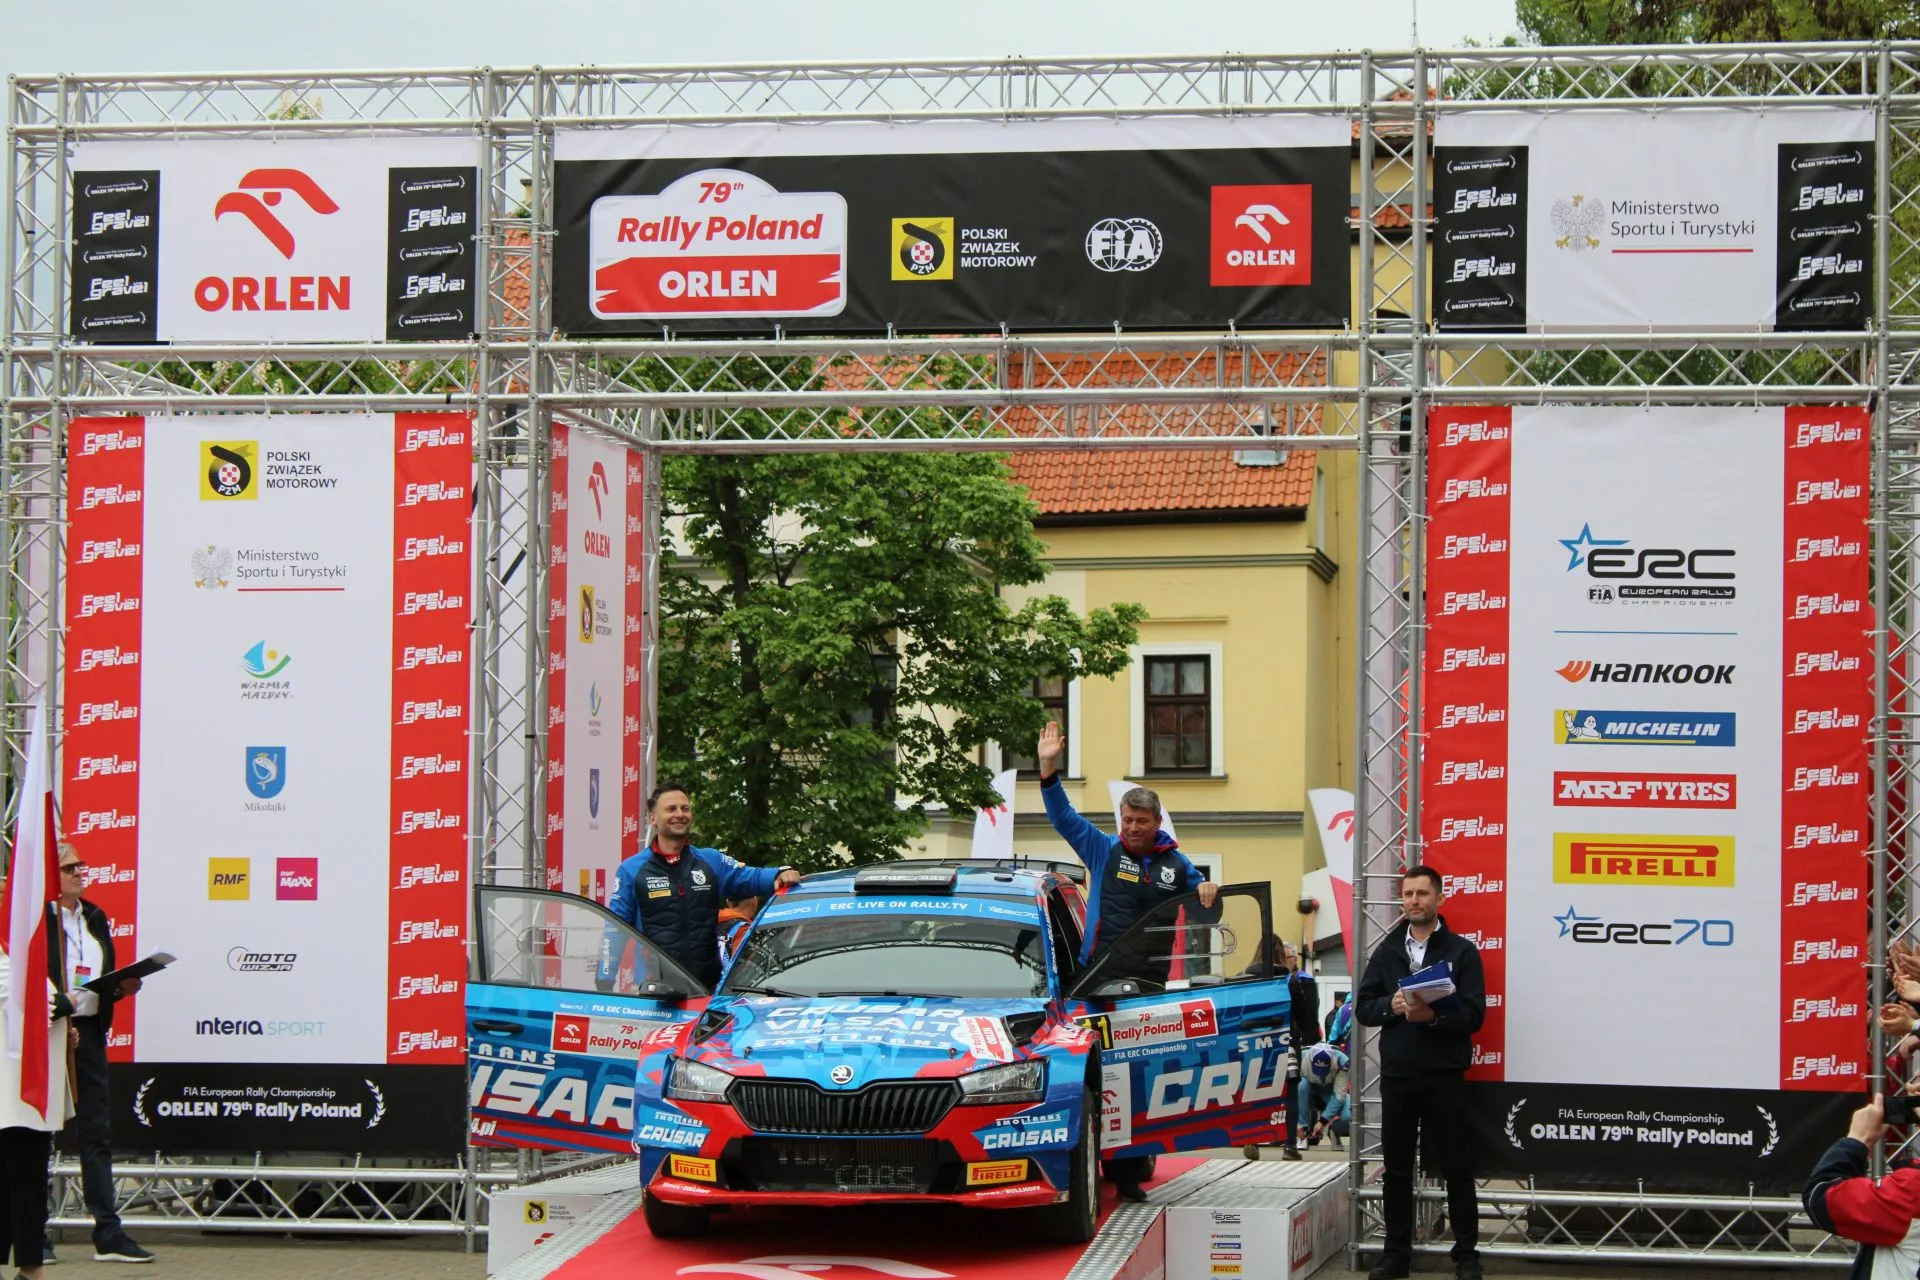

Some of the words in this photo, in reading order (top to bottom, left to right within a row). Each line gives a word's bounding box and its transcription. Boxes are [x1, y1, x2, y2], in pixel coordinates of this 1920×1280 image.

[698, 182, 744, 204] 79th
[1455, 187, 1497, 202] Feel
[1801, 183, 1842, 199] Feel
[1447, 193, 1517, 213] gravel
[1610, 200, 1719, 215] Ministerstwo
[1792, 189, 1863, 211] gravel
[92, 210, 130, 224] Feel
[408, 206, 447, 221] Feel
[84, 216, 149, 235] gravel
[400, 212, 466, 232] gravel
[1610, 220, 1665, 238] Sportu
[1670, 221, 1676, 236] i
[1680, 219, 1755, 238] Turystyki
[617, 216, 702, 250] Rally
[705, 213, 824, 242] Poland
[961, 228, 1008, 240] POLSKI
[961, 241, 1020, 256] ZWIĄZEK
[961, 255, 1037, 268] MOTOROWY
[1226, 249, 1295, 266] ORLEN
[1454, 256, 1495, 271] Feel
[1800, 254, 1841, 269] Feel
[910, 263, 935, 275] PZM
[1446, 262, 1515, 282] gravel
[1791, 260, 1862, 281] gravel
[91, 276, 129, 290] Feel
[408, 273, 446, 288] Feel
[658, 270, 777, 299] ORLEN
[83, 282, 148, 301] gravel
[194, 276, 351, 312] ORLEN
[400, 279, 465, 299] gravel
[1799, 422, 1841, 436] Feel
[1791, 428, 1861, 447] gravel
[267, 452, 310, 461] POLSKI
[266, 465, 322, 477] ZWIĄZEK
[85, 484, 122, 498] Feel
[218, 484, 241, 496] PZM
[266, 478, 338, 488] MOTOROWY
[1446, 477, 1487, 492] Feel
[77, 490, 141, 509] gravel
[1438, 483, 1507, 503] gravel
[407, 536, 444, 550] Feel
[584, 530, 610, 559] ORLEN
[237, 549, 319, 561] Ministerstwo
[399, 542, 463, 561] gravel
[1587, 548, 1736, 579] ERC
[236, 565, 278, 579] Sportu
[282, 565, 286, 577] i
[290, 565, 346, 579] Turystyki
[1445, 590, 1486, 604] Feel
[1621, 588, 1689, 596] EUROPEAN
[1691, 588, 1733, 596] RALLY
[1437, 596, 1506, 615] gravel
[1788, 656, 1859, 676] gravel
[1797, 651, 1838, 665] Feel
[240, 681, 290, 689] WARMIA
[240, 691, 290, 699] MAZURY
[74, 706, 137, 726] gravel
[82, 701, 119, 715] Feel
[1444, 703, 1484, 717] Feel
[1436, 708, 1504, 728] gravel
[1605, 721, 1721, 737] MICHELIN
[1559, 779, 1642, 800] MRF
[1646, 781, 1731, 802] TYRES
[395, 814, 460, 834] gravel
[403, 809, 441, 823] Feel
[1570, 841, 1720, 877] PIRELLI
[213, 873, 246, 886] RMF
[830, 901, 854, 910] ERC
[858, 901, 886, 909] LIVE
[910, 901, 969, 910] RALLY.TV
[1787, 944, 1857, 964] gravel
[1795, 939, 1837, 953] Feel
[243, 953, 297, 963] MOTO
[241, 963, 293, 971] WIZJA
[392, 980, 457, 999] gravel
[400, 975, 438, 988] Feel
[592, 1004, 604, 1012] FIA
[607, 1005, 621, 1013] ERC
[622, 1007, 673, 1019] Championship
[196, 1017, 263, 1036] interia
[266, 1021, 326, 1036] SPORT
[764, 1016, 960, 1031] VILSAIT
[1113, 1029, 1142, 1041] Rally
[1143, 1020, 1183, 1036] Poland
[1190, 1021, 1209, 1029] ORLEN
[560, 1036, 581, 1044] ORLEN
[589, 1035, 621, 1051] Rally
[1114, 1052, 1126, 1060] FIA
[1127, 1050, 1140, 1058] ERC
[1142, 1043, 1187, 1056] Championship
[183, 1087, 198, 1097] FIA
[201, 1087, 243, 1099] European
[246, 1087, 268, 1100] Rally
[270, 1087, 336, 1099] Championship
[157, 1102, 218, 1117] ORLEN
[223, 1101, 252, 1117] 79th
[255, 1103, 298, 1122] Rally
[301, 1103, 362, 1119] Poland
[1559, 1109, 1574, 1119] FIA
[1576, 1109, 1623, 1123] European
[1626, 1110, 1650, 1125] Rally
[1652, 1111, 1724, 1125] Championship
[638, 1124, 707, 1148] CRUSAR
[983, 1127, 1068, 1150] CRUSAR
[1530, 1123, 1596, 1141] ORLEN
[1601, 1125, 1634, 1142] 79th
[1637, 1127, 1684, 1148] Rally
[1687, 1128, 1753, 1146] Poland
[674, 1159, 711, 1177] PIRELLI
[972, 1164, 1023, 1181] PIRELLI
